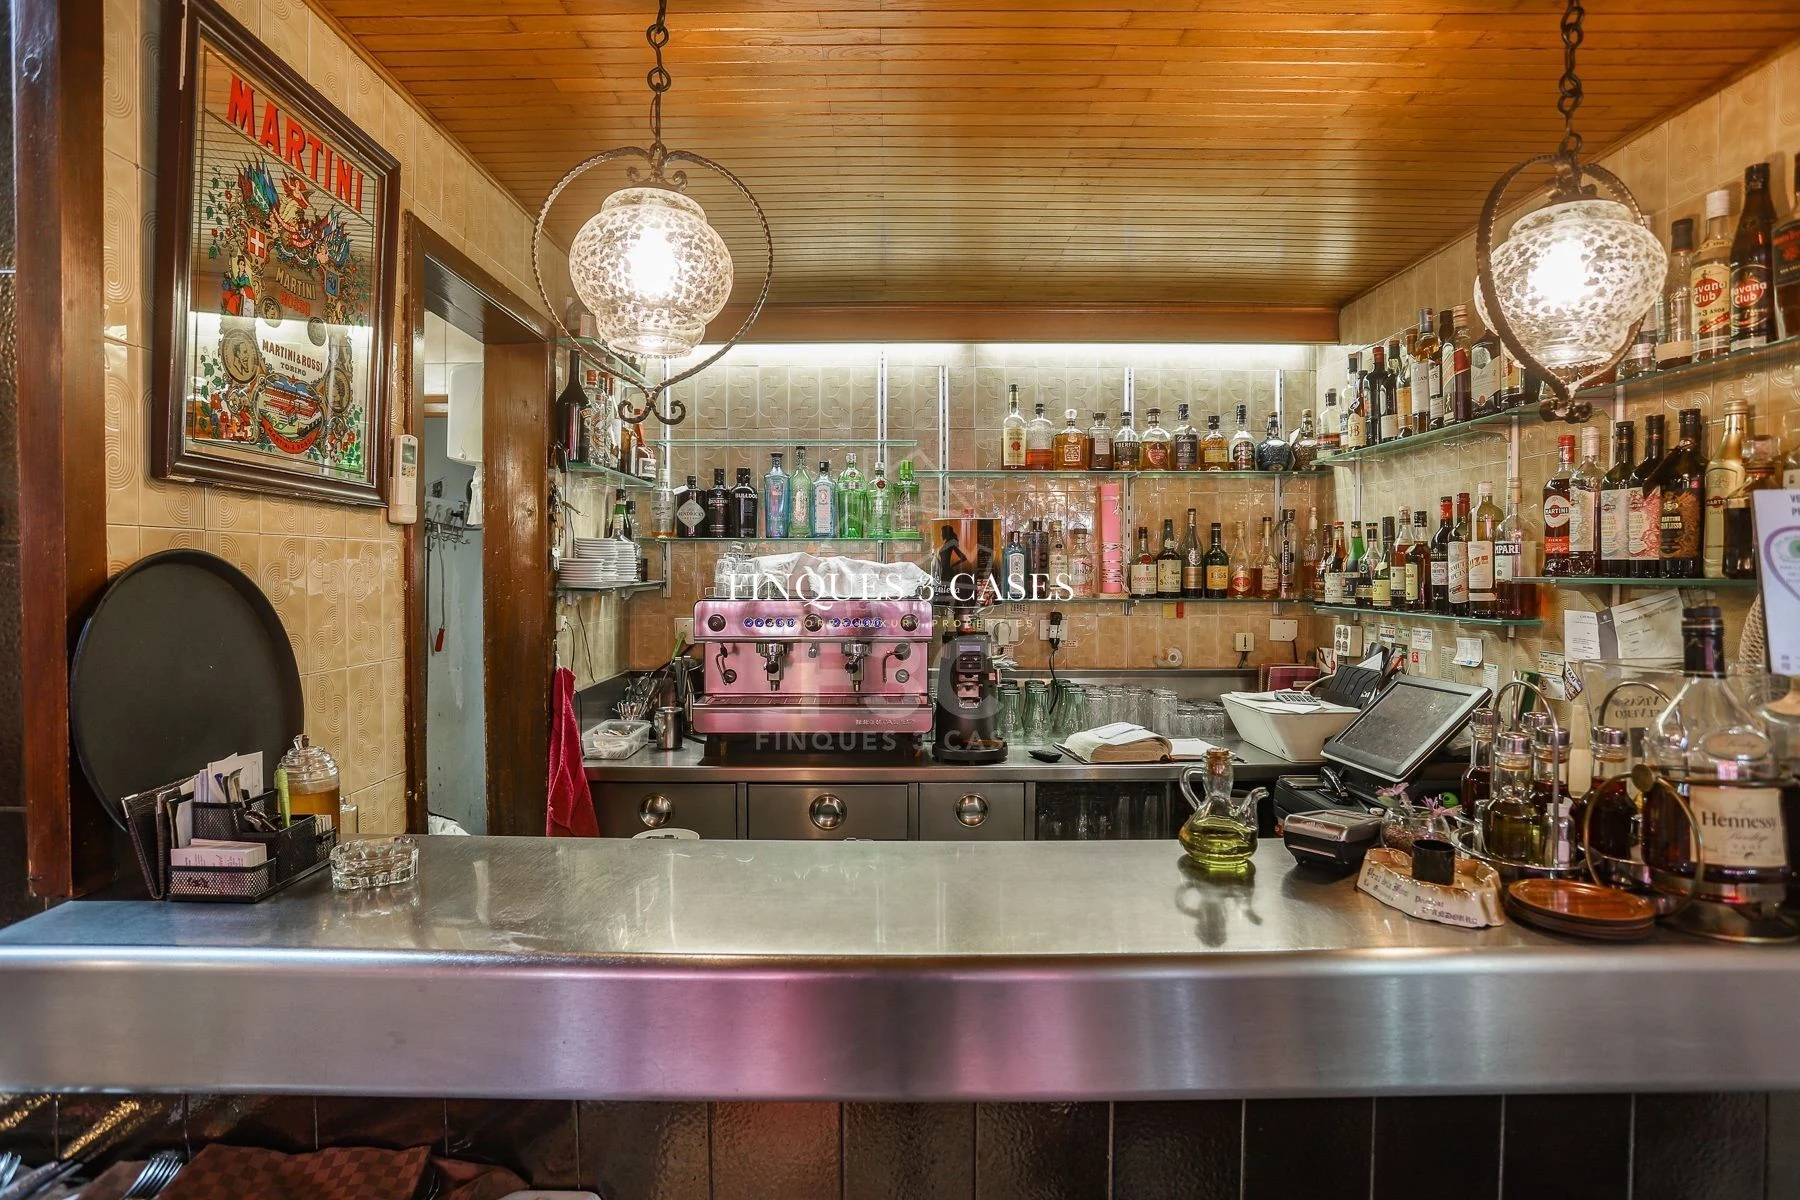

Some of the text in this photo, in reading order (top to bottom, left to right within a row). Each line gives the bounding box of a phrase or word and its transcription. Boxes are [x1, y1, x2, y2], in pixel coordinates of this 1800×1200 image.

[227, 73, 365, 214] MARTINI
[276, 267, 317, 300] MARTINI
[1694, 291, 1717, 305] Club
[1735, 293, 1758, 305] Club
[280, 362, 307, 376] TORINO
[1544, 507, 1569, 515] MARTINI
[1495, 544, 1521, 554] MPARI
[1566, 667, 1577, 683] TAXI
[1701, 811, 1777, 832] Hennessy
